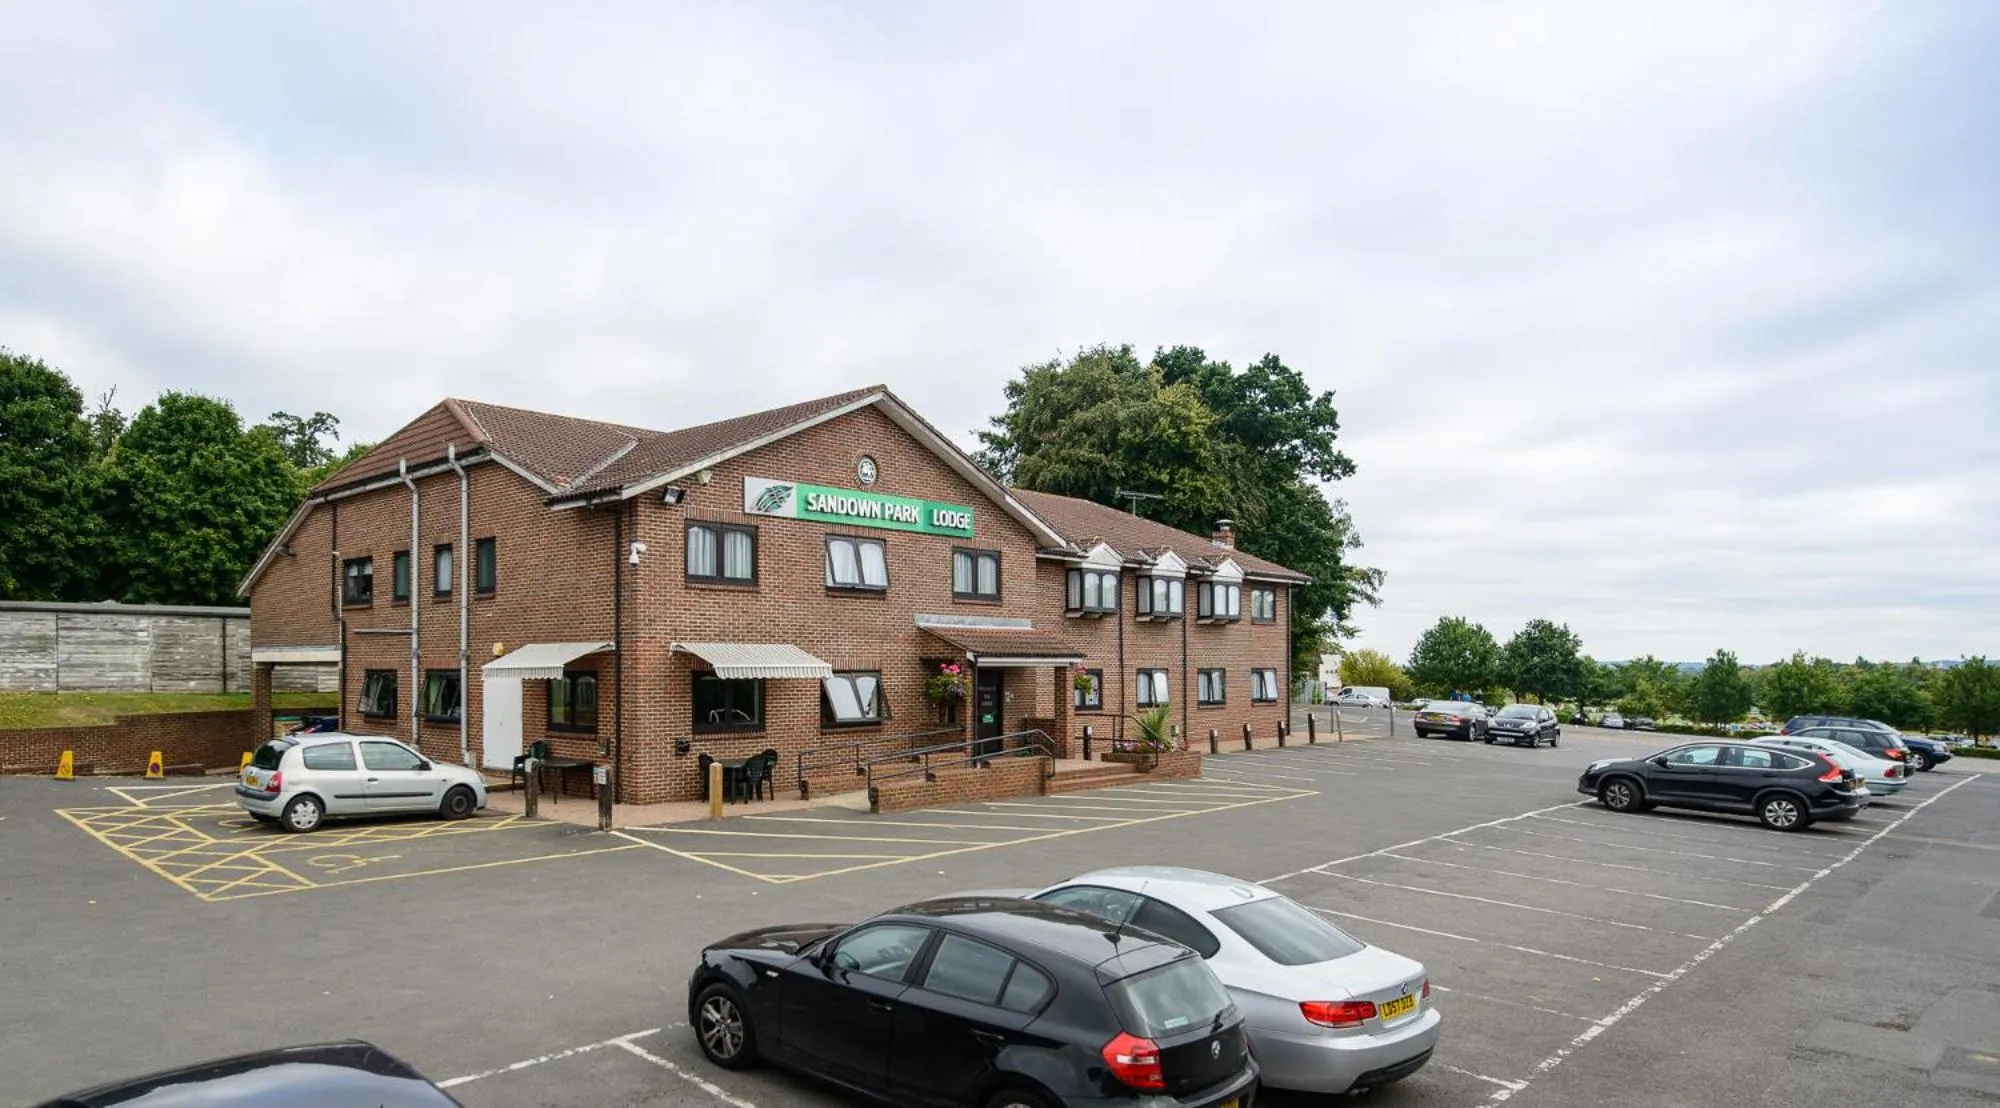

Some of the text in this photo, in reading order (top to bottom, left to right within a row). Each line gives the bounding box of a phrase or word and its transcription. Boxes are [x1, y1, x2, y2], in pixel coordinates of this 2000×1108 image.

[806, 492, 971, 529] SANDOWN PARK LODGE
